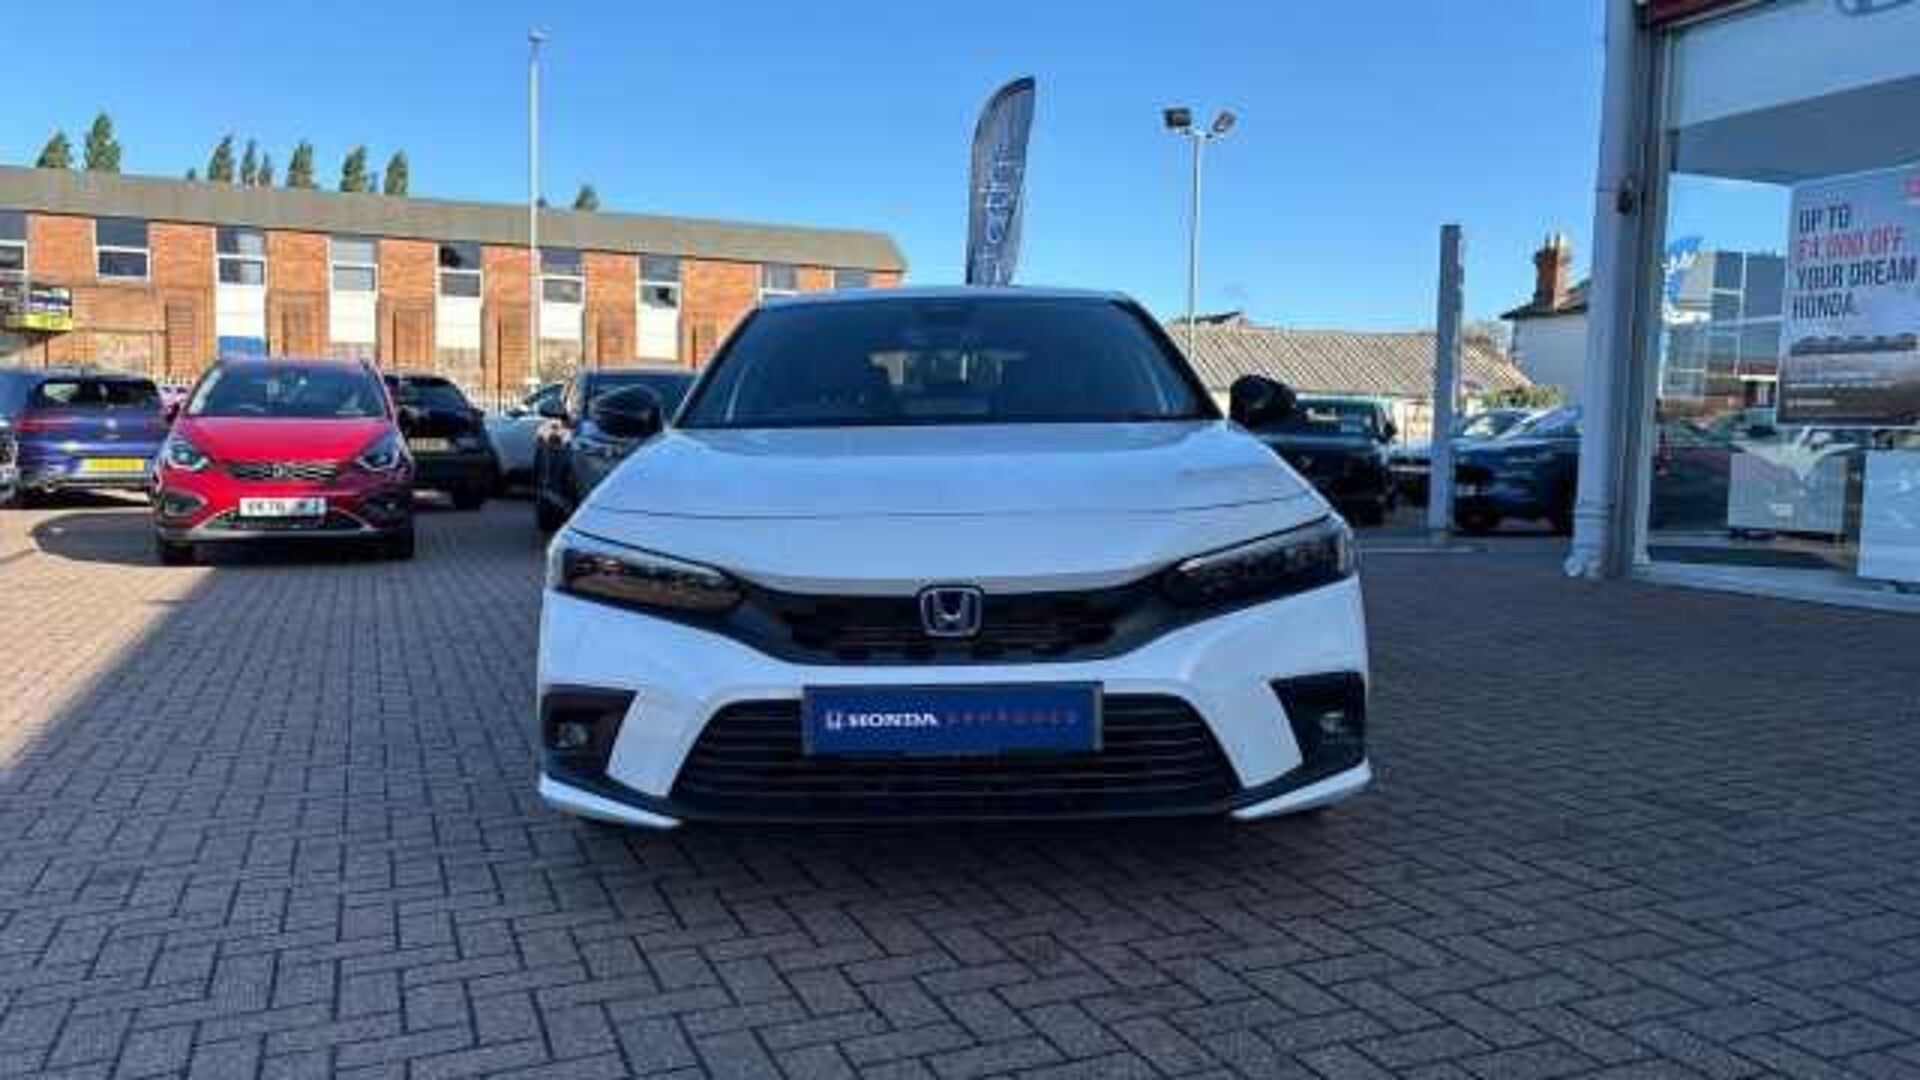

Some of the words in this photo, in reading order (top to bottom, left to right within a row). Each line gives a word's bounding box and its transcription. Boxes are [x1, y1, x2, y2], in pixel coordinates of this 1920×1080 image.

[1799, 207, 1824, 234] UP
[1827, 203, 1850, 230] TO
[1796, 263, 1843, 290] YOUR
[1847, 257, 1917, 287] DREAM
[847, 711, 940, 729] HONDA
